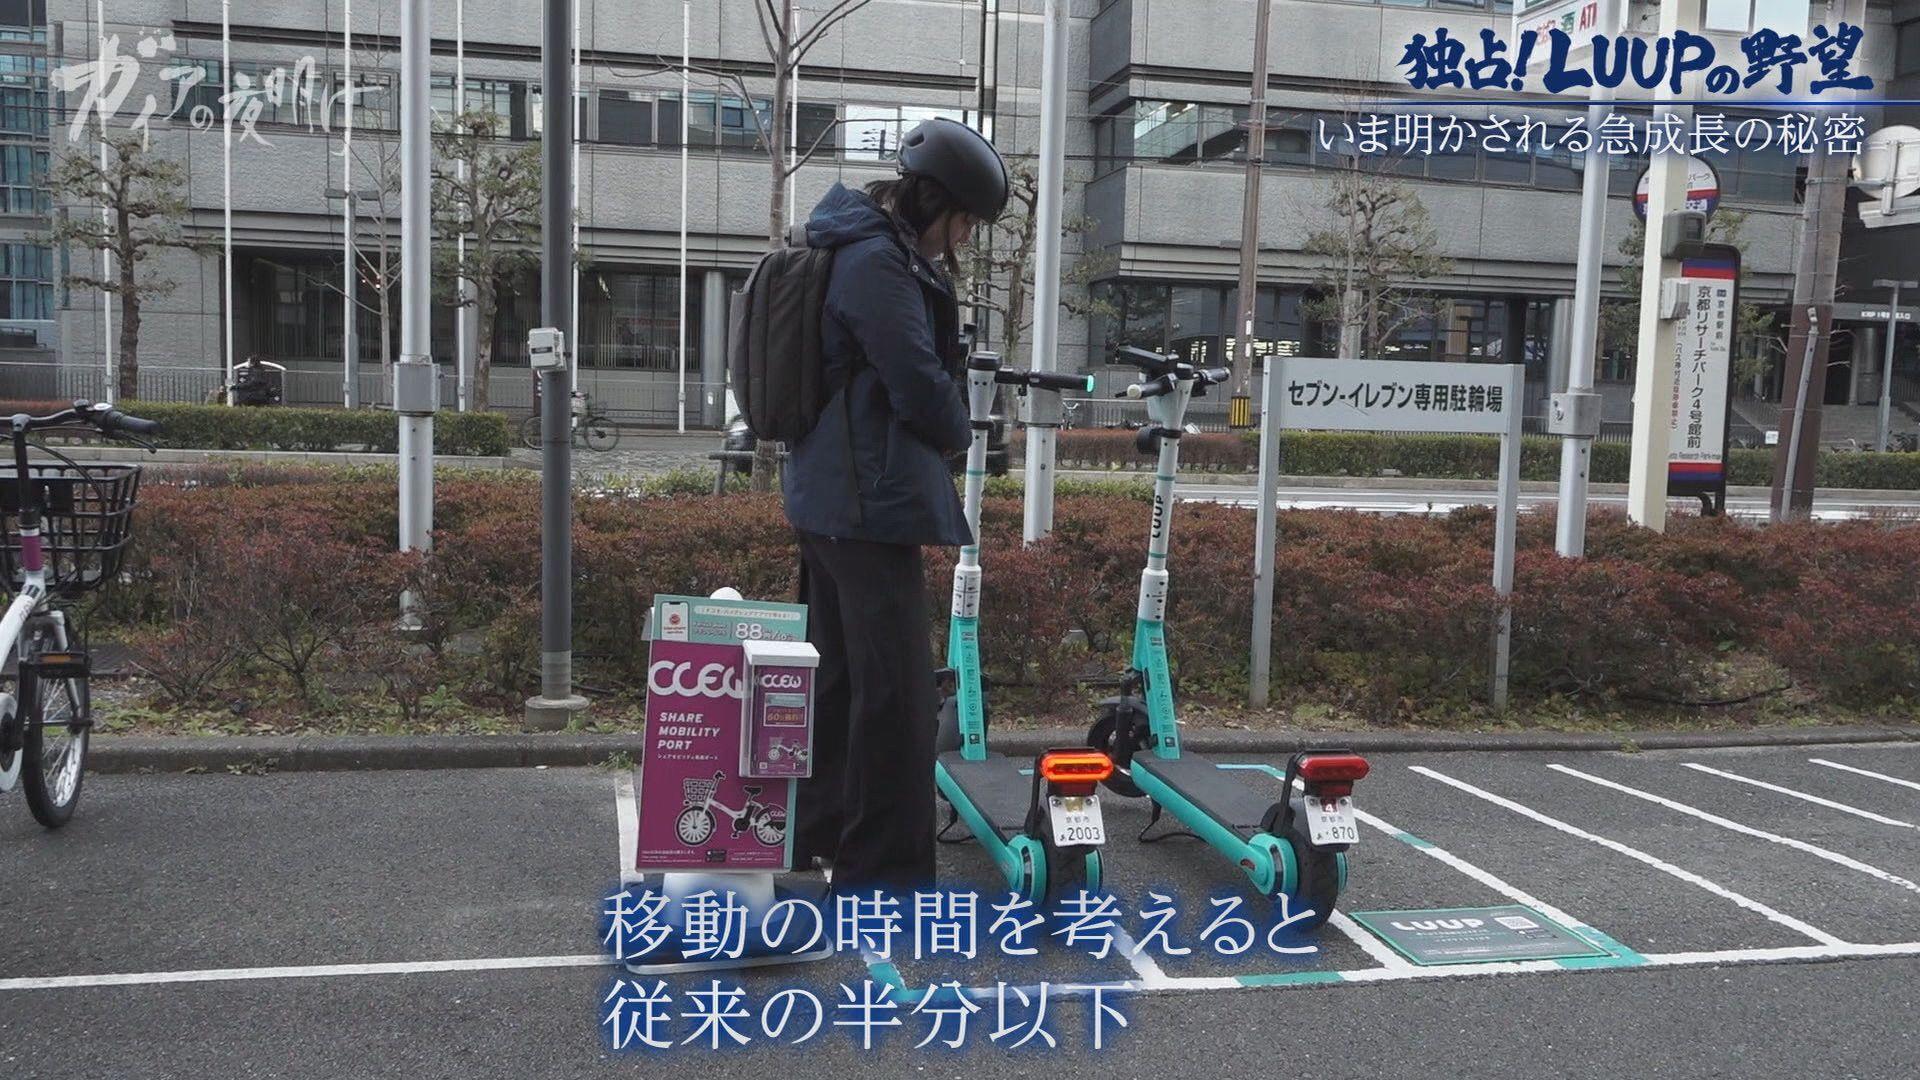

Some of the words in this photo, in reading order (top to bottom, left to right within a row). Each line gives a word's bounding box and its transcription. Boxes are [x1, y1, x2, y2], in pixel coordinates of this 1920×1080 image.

[1687, 285, 1713, 449] 京都リサーチパーク4号館前
[1152, 495, 1164, 539] LUUP
[660, 712, 704, 723] SHARE
[658, 726, 721, 738] MOBILITY
[657, 739, 693, 750] PORT
[1067, 826, 1101, 841] 2003
[1391, 918, 1485, 931] LUUP
